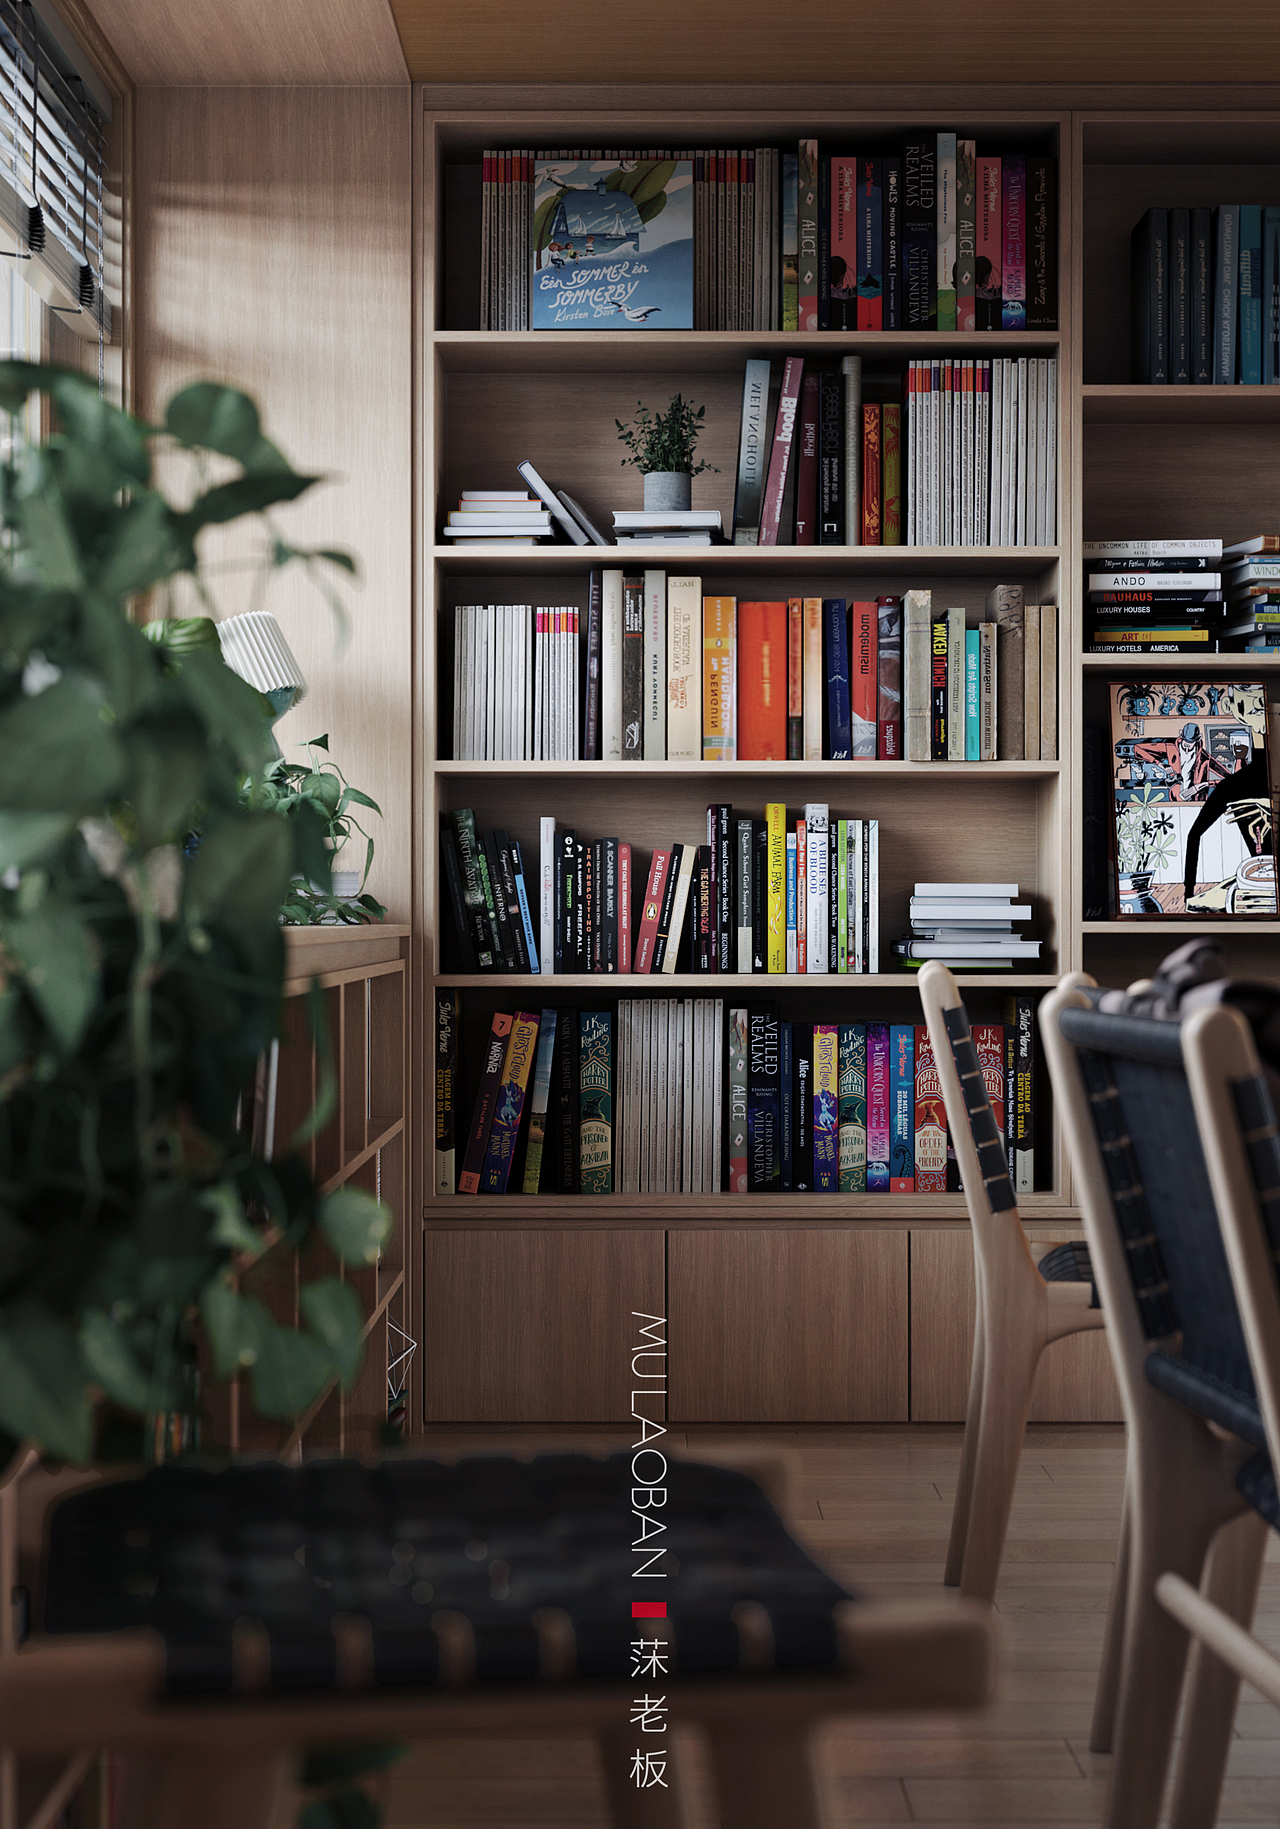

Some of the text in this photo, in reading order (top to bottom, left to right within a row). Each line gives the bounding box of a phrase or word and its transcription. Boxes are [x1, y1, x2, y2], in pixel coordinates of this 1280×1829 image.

[843, 167, 853, 213] Jules Verne
[906, 145, 920, 207] REALMS
[919, 152, 934, 209] VEILED
[990, 167, 998, 213] Jules Verne
[801, 219, 815, 257] ALICE
[959, 219, 974, 259] ALICE
[889, 239, 897, 269] CASTLE
[540, 261, 650, 290] Ein SOMMER in
[908, 246, 920, 324] VILLANUEVA
[920, 248, 930, 322] CHRISTOPHER
[548, 280, 640, 309] SOMMERBY
[554, 304, 616, 322] Kirsten Boie
[1099, 542, 1129, 550] UNCOMMON
[1113, 577, 1146, 586] ANDO
[1103, 592, 1153, 602] BAUHAUS
[1123, 606, 1151, 614] HOUSES
[1089, 645, 1115, 653] LUXURY
[1121, 633, 1139, 641] ART
[459, 828, 474, 863] NINTH
[772, 833, 785, 868] ANIMAL
[606, 850, 614, 886] SCANNER
[651, 855, 666, 896] Full House
[810, 842, 818, 895] OF BLOOD
[819, 849, 827, 874] BLUE
[722, 807, 731, 970] paul green Second Chance Series Book One BEGINNINGS
[772, 871, 784, 895] FARM
[819, 877, 827, 897] SEA
[494, 883, 507, 922] INFERNO
[606, 888, 614, 918] DARKLY
[701, 880, 710, 917] GATHERING
[701, 917, 710, 934] DEAD
[439, 1002, 452, 1054] Jules Verne
[498, 1021, 507, 1032] 7
[1020, 1008, 1032, 1057] Jules Verne
[751, 1015, 765, 1074] REALMS
[765, 1021, 778, 1075] VEILED
[583, 1064, 607, 1078] HARRY
[583, 1075, 607, 1087] POTTER
[799, 1058, 810, 1079] Alice
[841, 1072, 863, 1085] HARRY
[444, 1069, 452, 1111] VIAGEM AO
[733, 1084, 747, 1122] ALICE
[902, 1090, 908, 1099] 20
[437, 1101, 444, 1111] DA
[1017, 1104, 1024, 1115] DA
[1024, 1102, 1031, 1113] AO
[902, 1113, 910, 1140] LÉGUAS
[754, 1110, 765, 1184] VILLANUEVA
[765, 1112, 774, 1182] CHRISTOPHER
